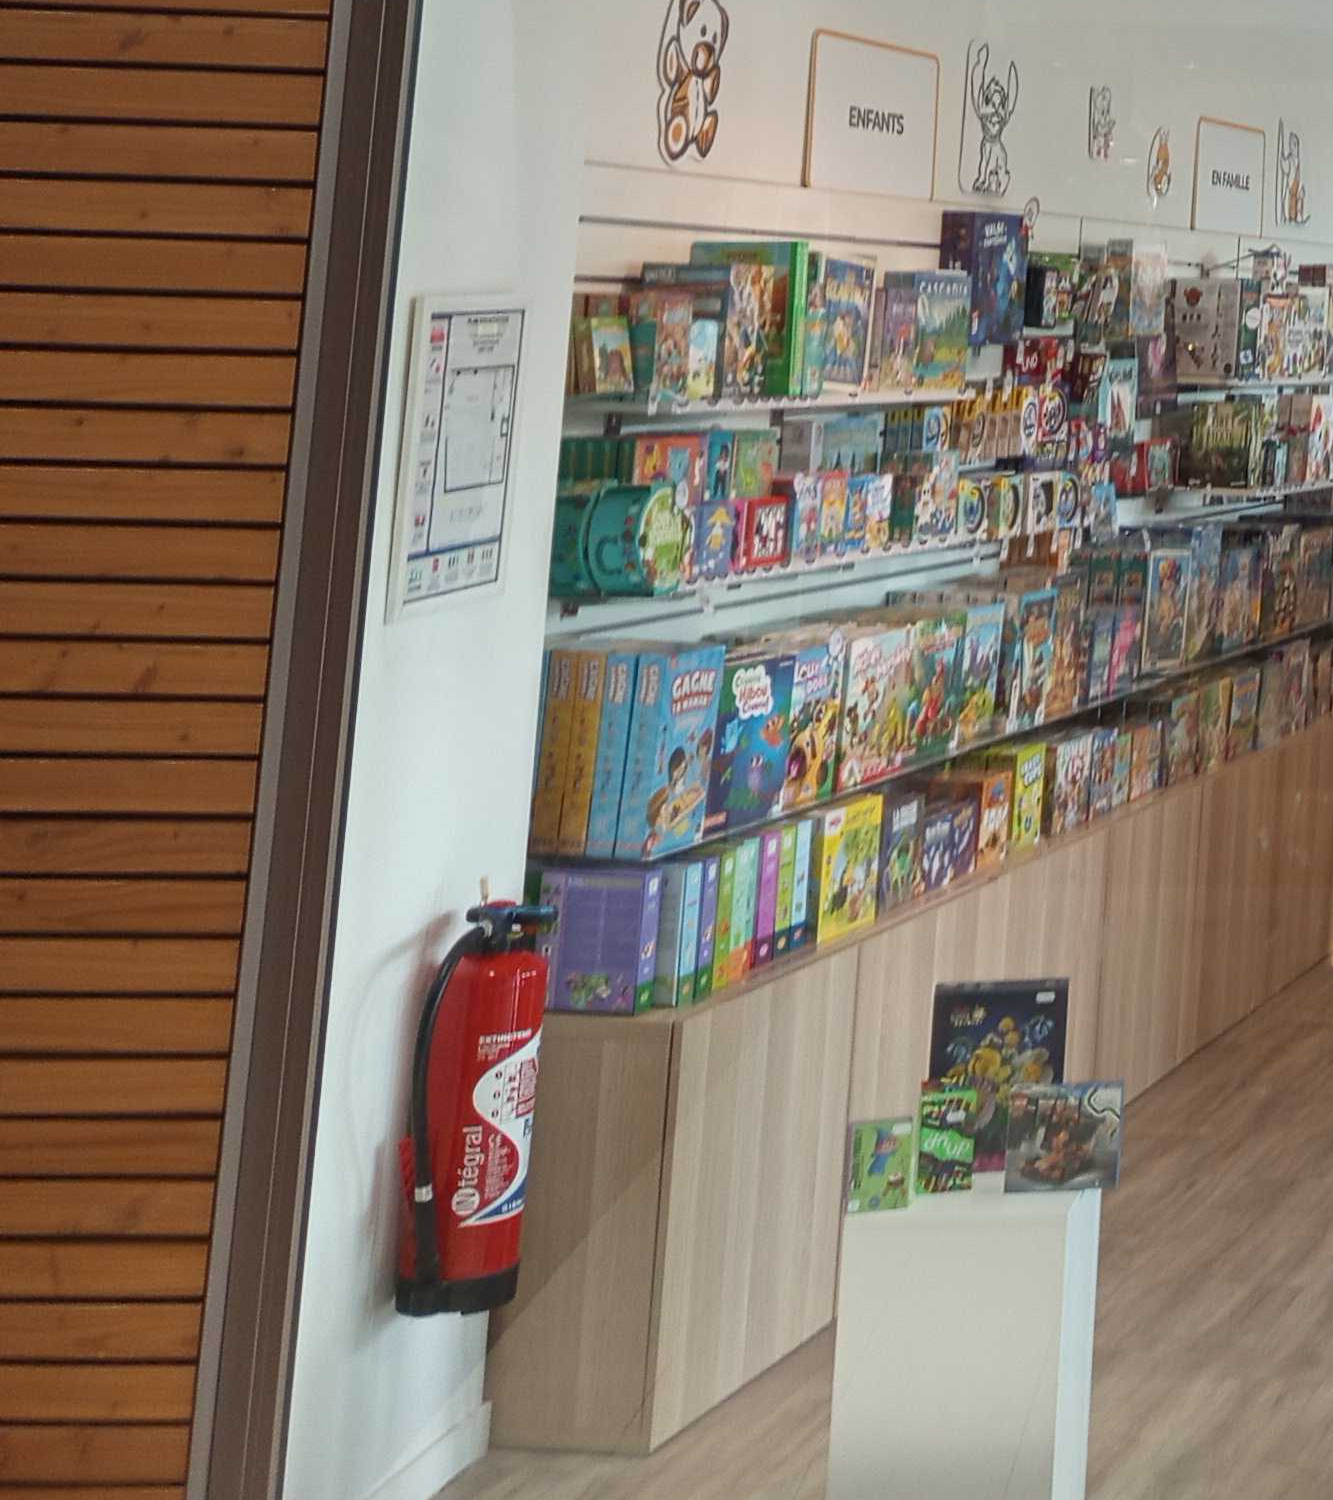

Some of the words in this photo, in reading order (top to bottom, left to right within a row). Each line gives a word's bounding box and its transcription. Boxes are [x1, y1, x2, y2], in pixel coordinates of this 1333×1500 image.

[848, 104, 905, 136] ENFANTS
[1211, 169, 1223, 187] EN
[1223, 170, 1251, 191] FAMILLE
[918, 280, 968, 296] CASCADIA
[672, 669, 716, 699] GAGNE
